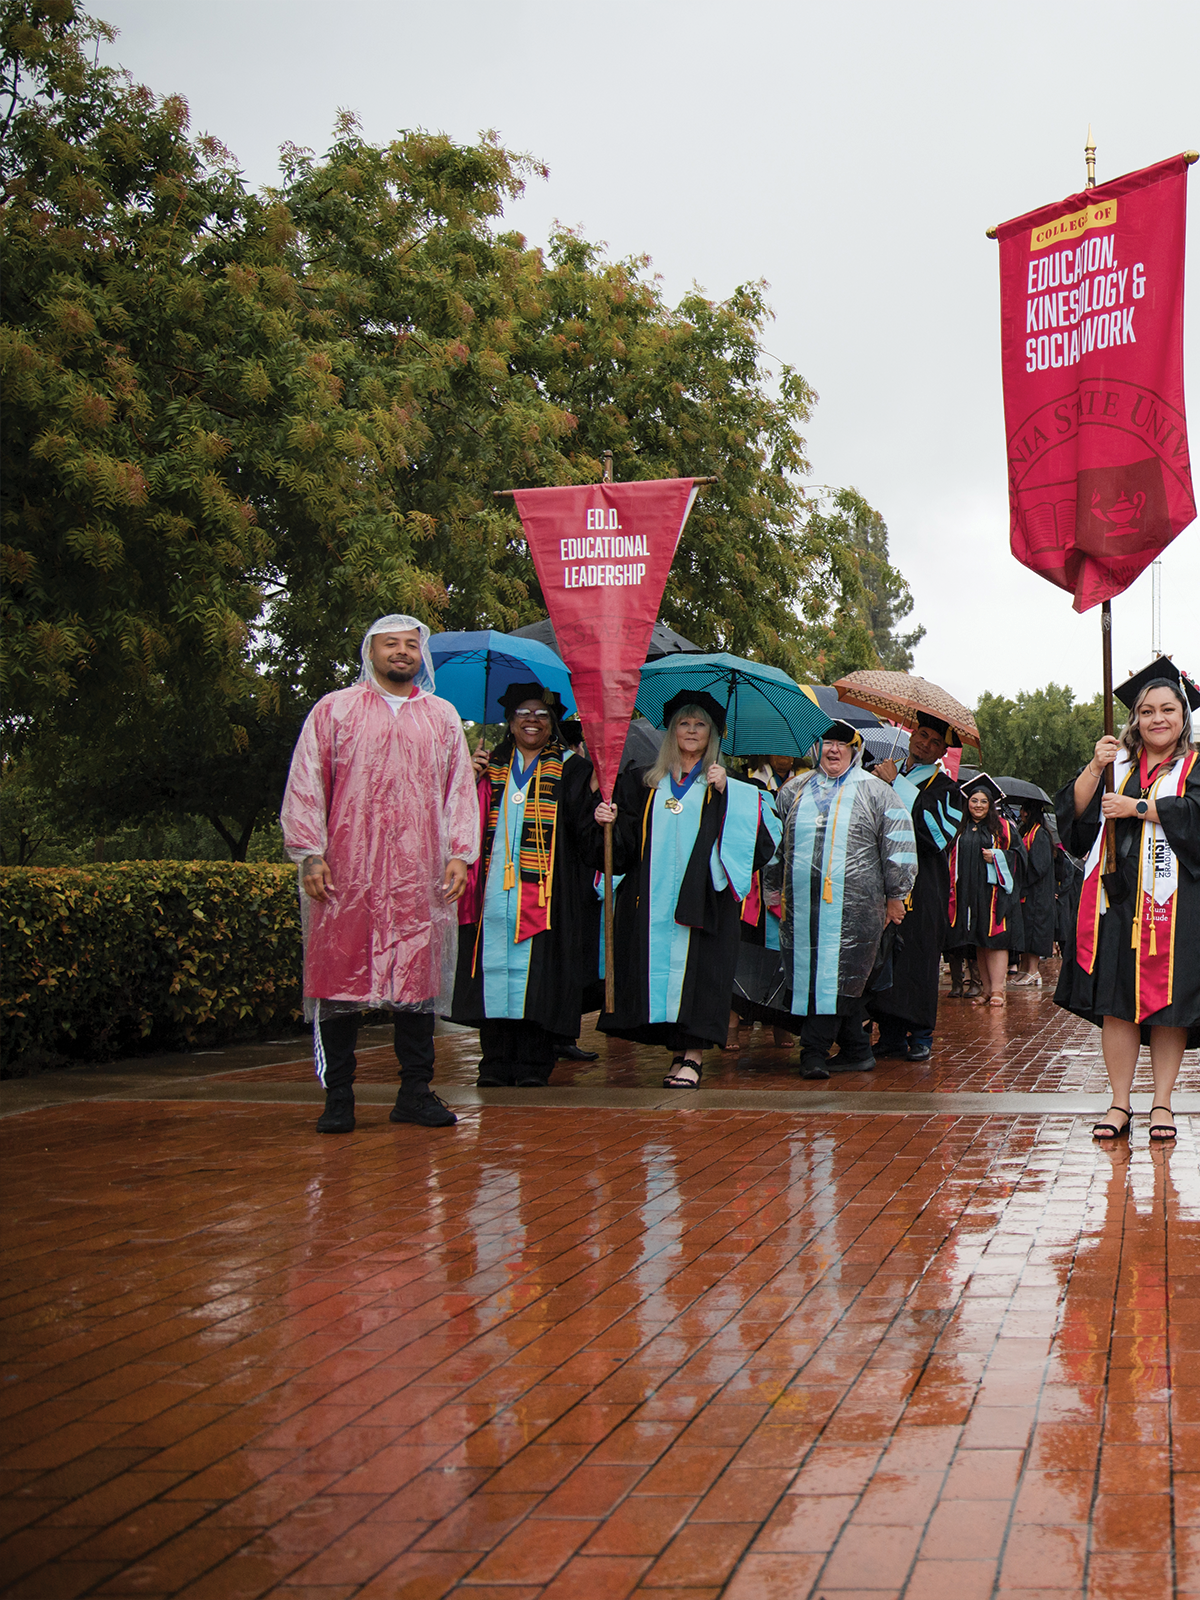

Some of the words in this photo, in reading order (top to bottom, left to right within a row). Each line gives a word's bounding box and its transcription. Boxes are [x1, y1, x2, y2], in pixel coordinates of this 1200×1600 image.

[1094, 207, 1112, 220] OF
[1027, 234, 1118, 294] EDUCATION,
[1132, 262, 1147, 300] &
[1081, 306, 1137, 355] WORK
[1054, 391, 1120, 434] STATE
[586, 508, 622, 530] ED.D.
[560, 534, 650, 561] EDUCATIONAL
[564, 563, 646, 589] LEADERSHIP
